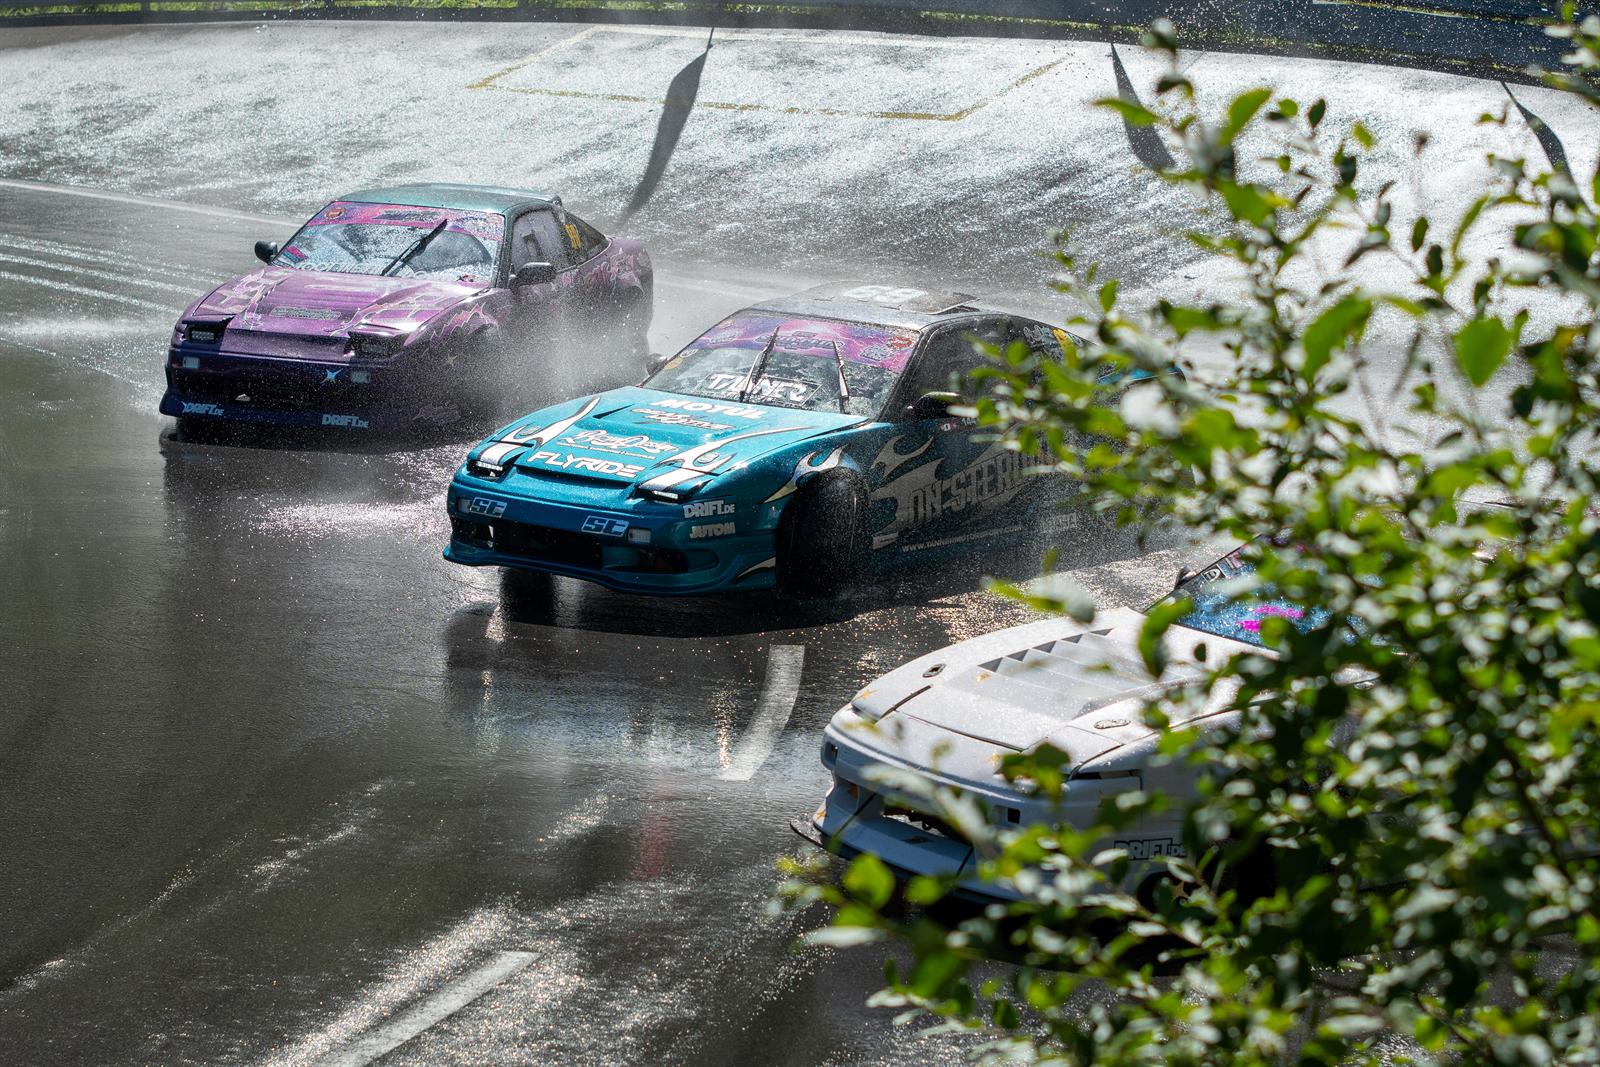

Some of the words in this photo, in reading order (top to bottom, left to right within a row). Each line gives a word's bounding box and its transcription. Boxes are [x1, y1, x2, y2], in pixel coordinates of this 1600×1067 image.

[185, 402, 224, 416] DRIFT.DE
[649, 399, 768, 419] MOTUL
[322, 414, 369, 428] DRIFT.DE
[527, 451, 647, 478] FLYRIDE
[683, 500, 736, 518] DRIFT.DE
